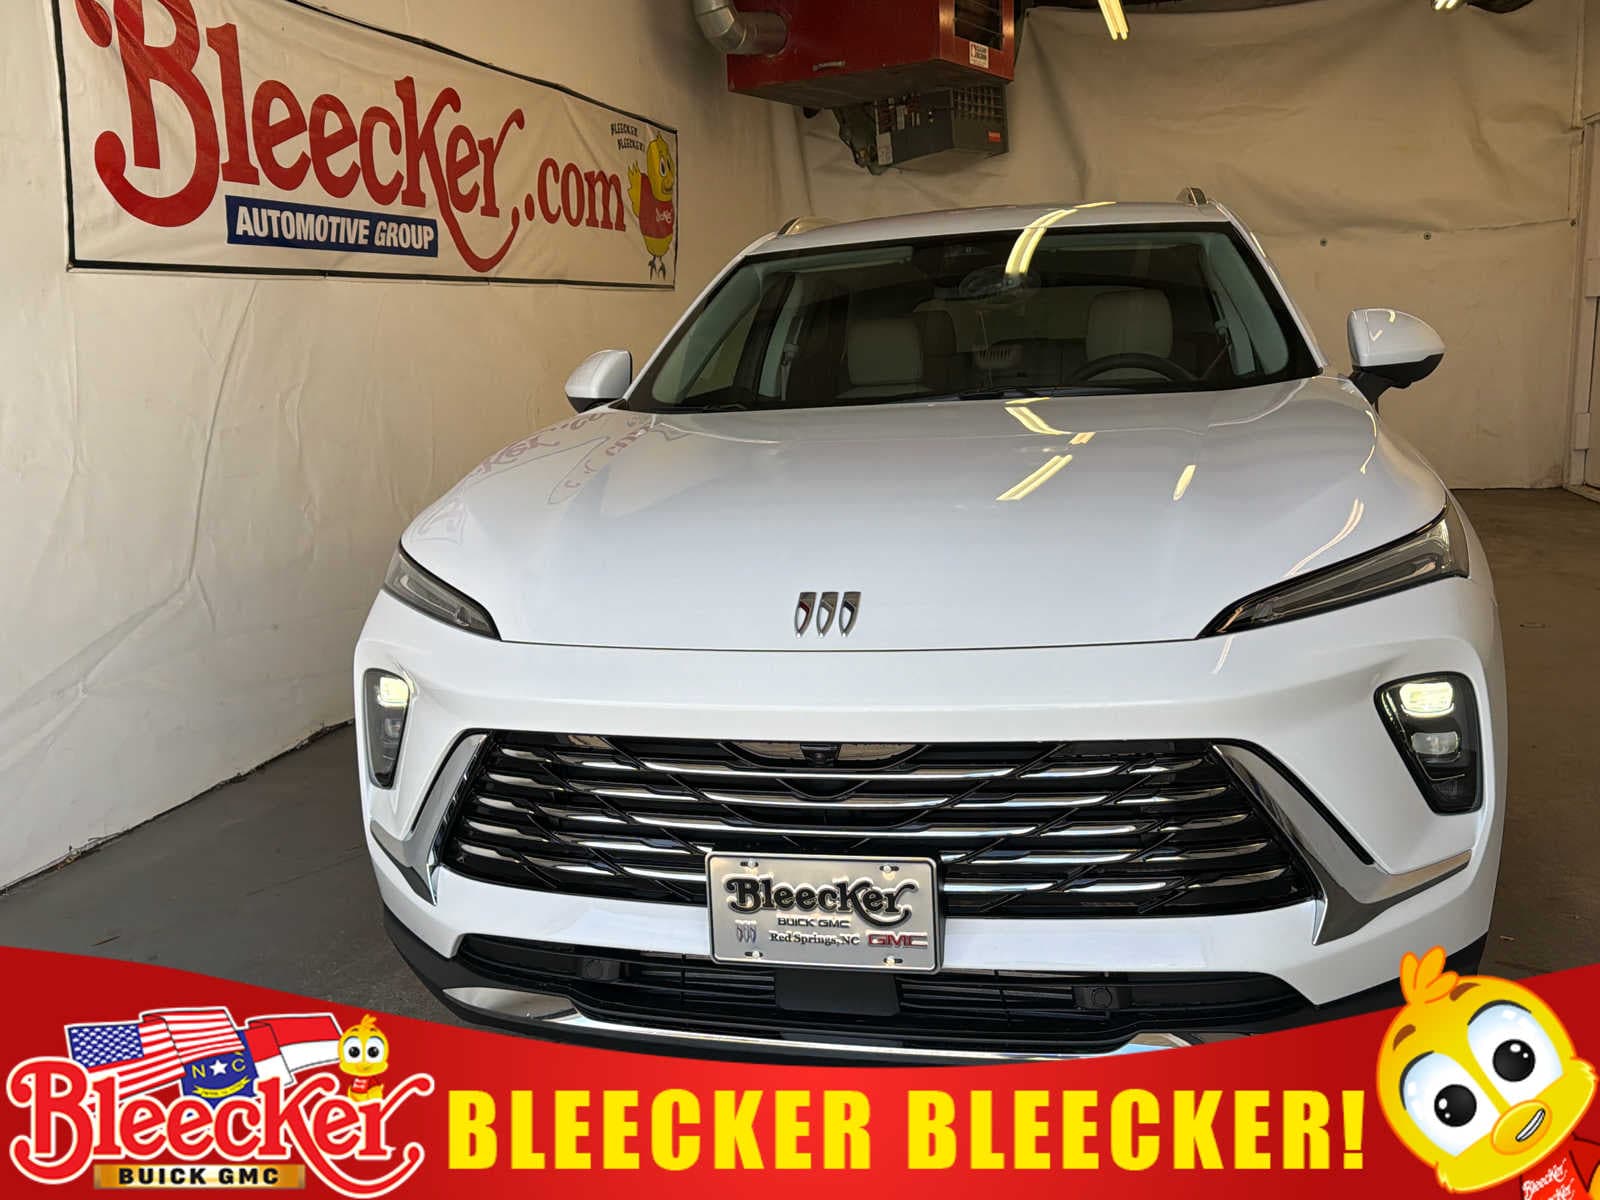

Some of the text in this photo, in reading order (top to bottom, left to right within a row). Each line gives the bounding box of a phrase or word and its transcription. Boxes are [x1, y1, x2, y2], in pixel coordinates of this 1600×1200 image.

[235, 205, 434, 250] AUTOMOTIVE GROUP
[777, 918, 850, 928] BUICK GMC
[770, 932, 793, 943] Red
[842, 935, 860, 945] NC
[868, 934, 928, 948] GMC
